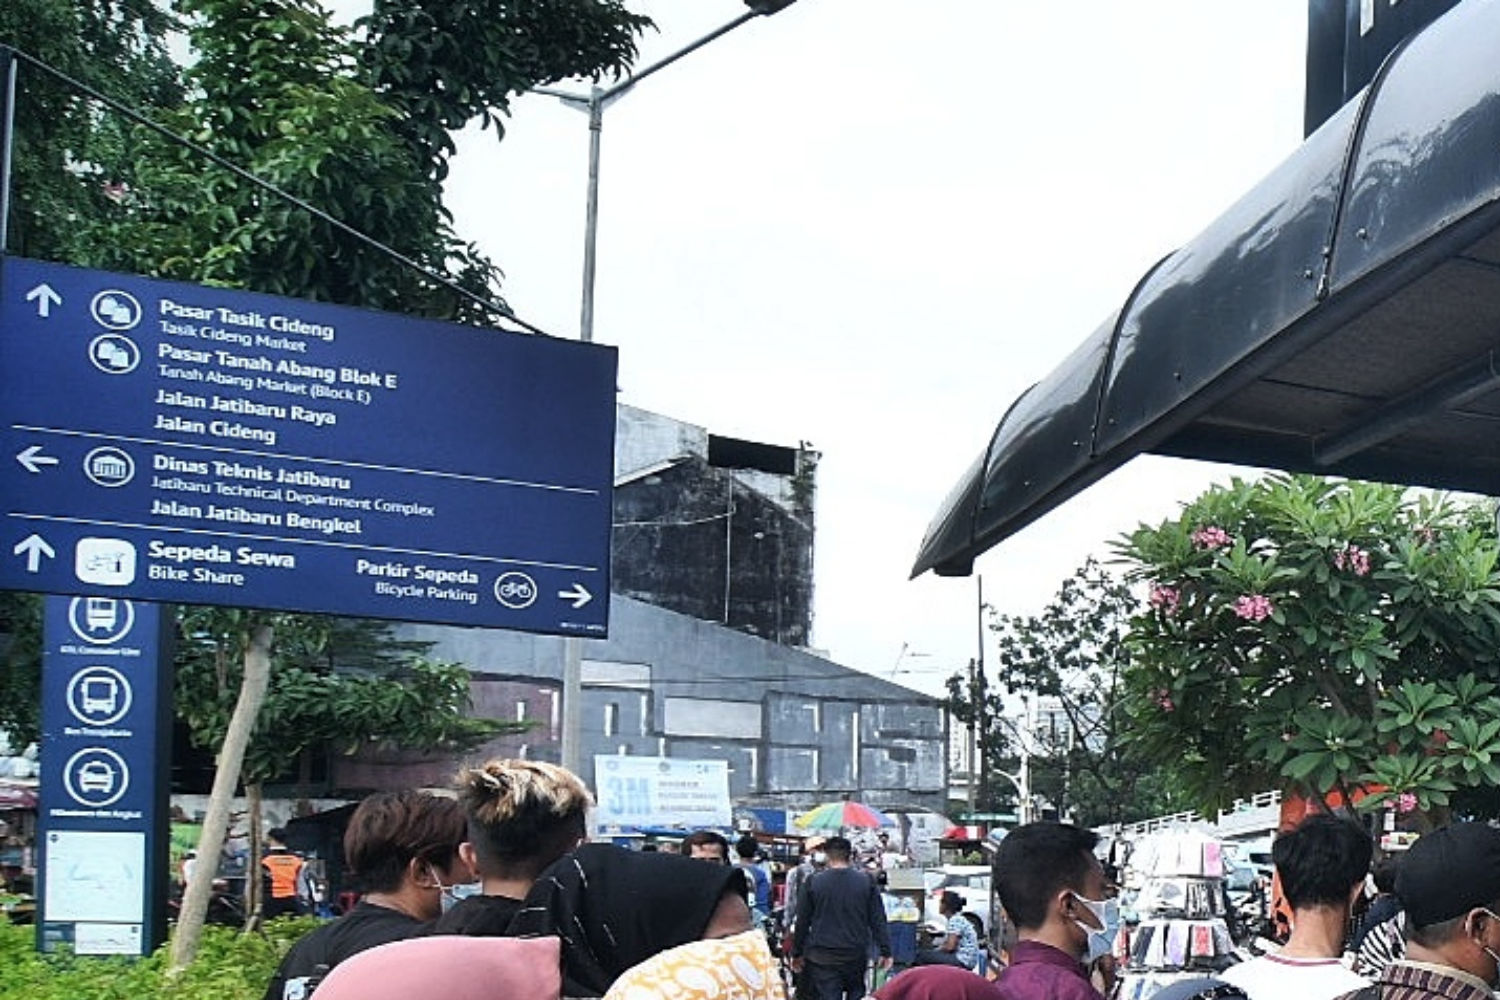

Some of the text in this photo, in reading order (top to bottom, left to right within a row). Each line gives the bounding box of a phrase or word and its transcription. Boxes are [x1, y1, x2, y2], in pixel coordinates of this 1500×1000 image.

[160, 299, 335, 340] Pasar Tasik Cideng
[160, 321, 307, 353] Tasik Cideng Market
[159, 343, 398, 389] Pasar Tanah Abang Blok E
[159, 364, 372, 405] Tanah Abang Market (Block E)
[156, 390, 336, 426] Jalan Jatibaru Raya
[154, 415, 276, 445] Jalan Cideng
[153, 455, 351, 490] Dinas Teknis Jatibaru
[151, 476, 435, 518] Jatibaru Technical Department Complex
[151, 500, 362, 535] Jalan Jatibaru Bengkel
[148, 541, 295, 568] Sepeda Sewa
[356, 559, 479, 585] Parkir Sepeda
[148, 565, 244, 586] Bike Share
[375, 582, 478, 604] Bicycle Parking
